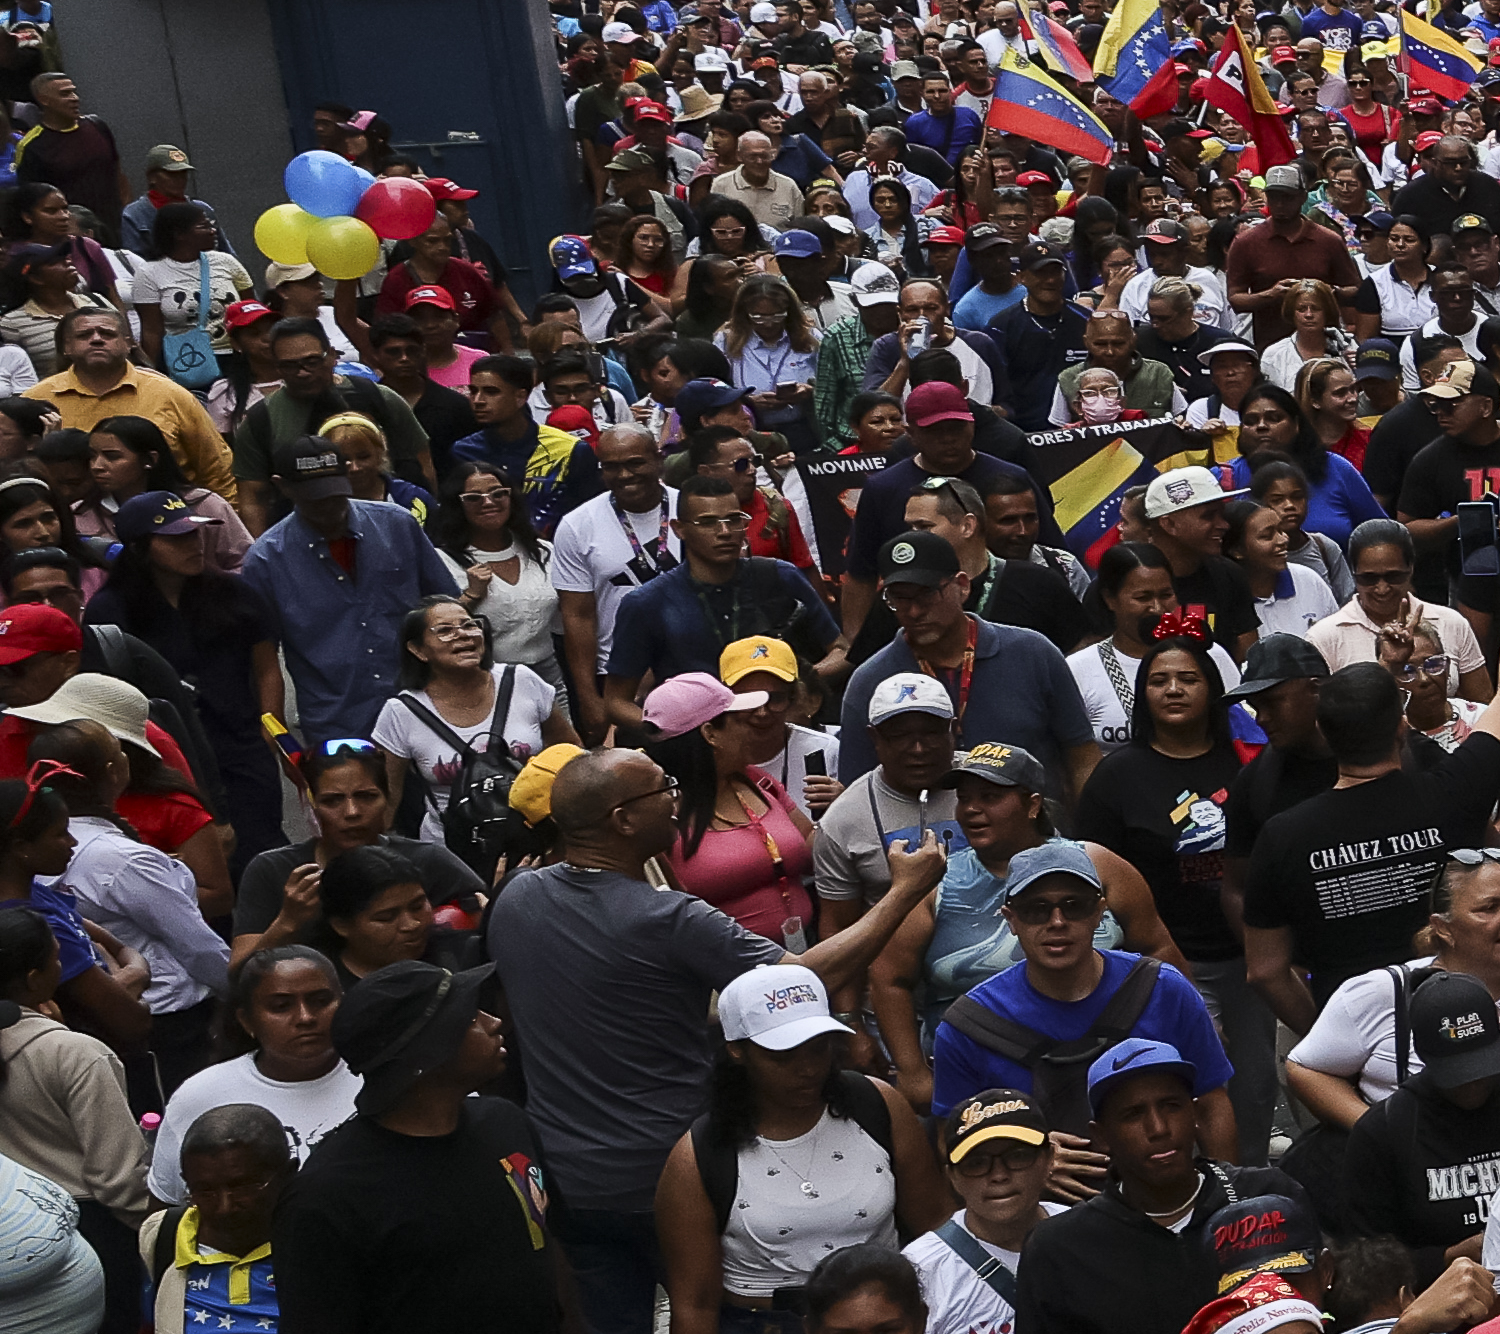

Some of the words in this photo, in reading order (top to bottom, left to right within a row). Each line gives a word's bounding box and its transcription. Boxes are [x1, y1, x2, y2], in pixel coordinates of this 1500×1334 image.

[1077, 424, 1088, 440] Y
[1309, 842, 1382, 872] CHÁVEZ
[1388, 827, 1443, 856] TOUR
[1456, 1012, 1480, 1025] PLAN
[1456, 1024, 1485, 1038] SUCRE
[1214, 1211, 1286, 1250] DUDAR
